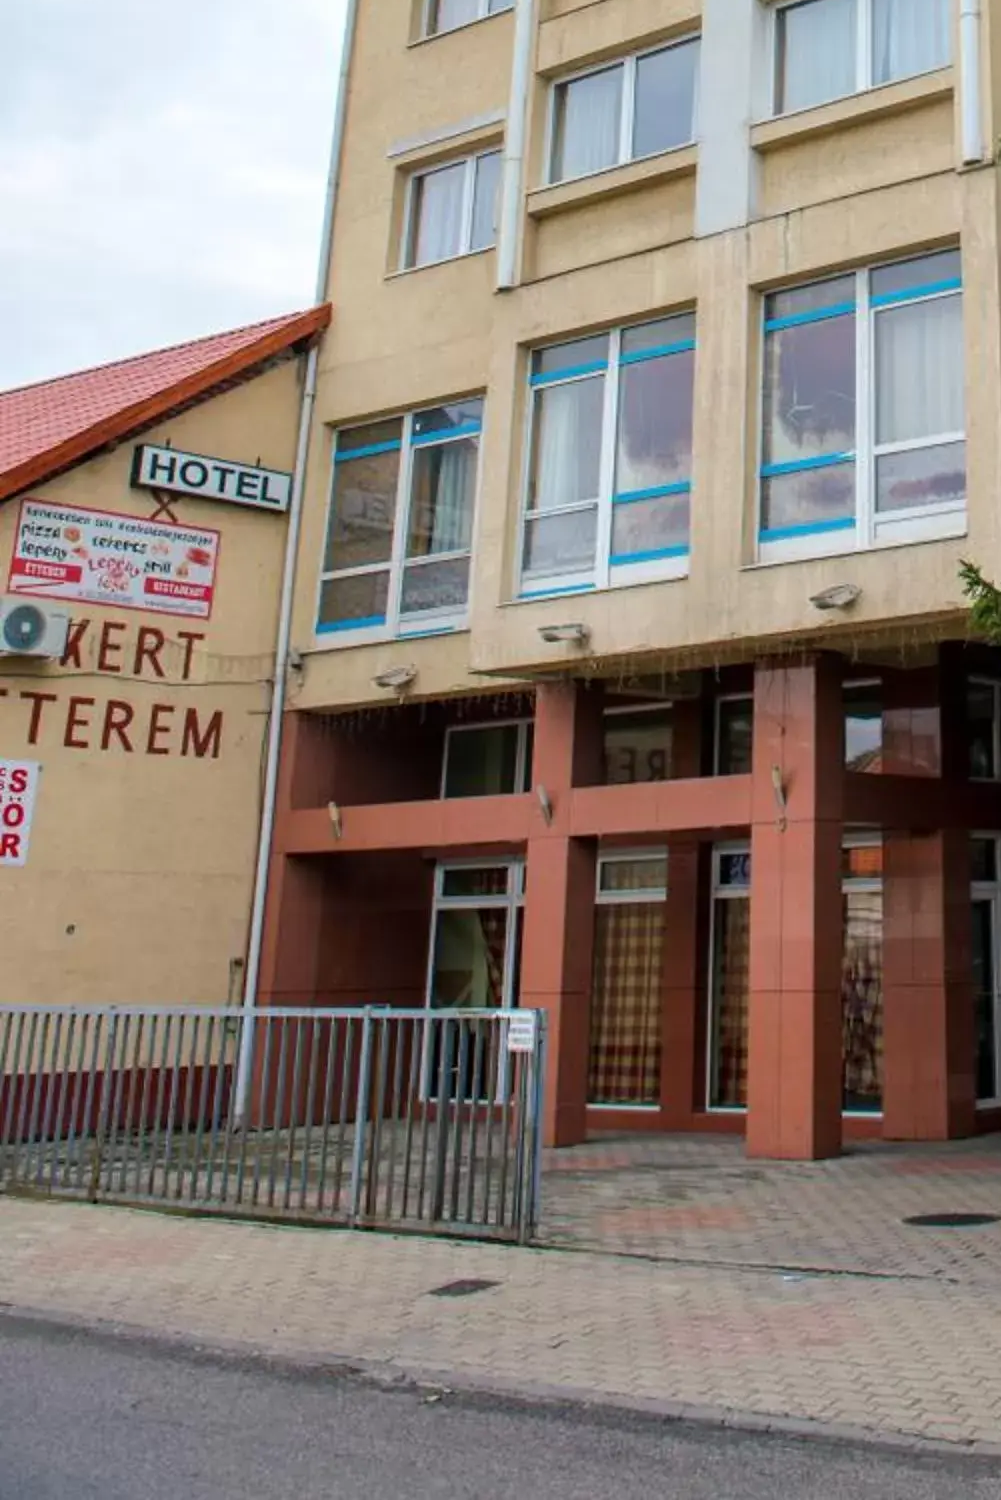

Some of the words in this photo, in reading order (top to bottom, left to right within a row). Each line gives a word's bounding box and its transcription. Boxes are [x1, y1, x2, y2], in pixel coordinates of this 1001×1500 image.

[149, 453, 281, 504] HOTEL
[21, 521, 61, 538] pizza
[59, 618, 205, 680] KERT
[0, 688, 223, 758] TEREM
